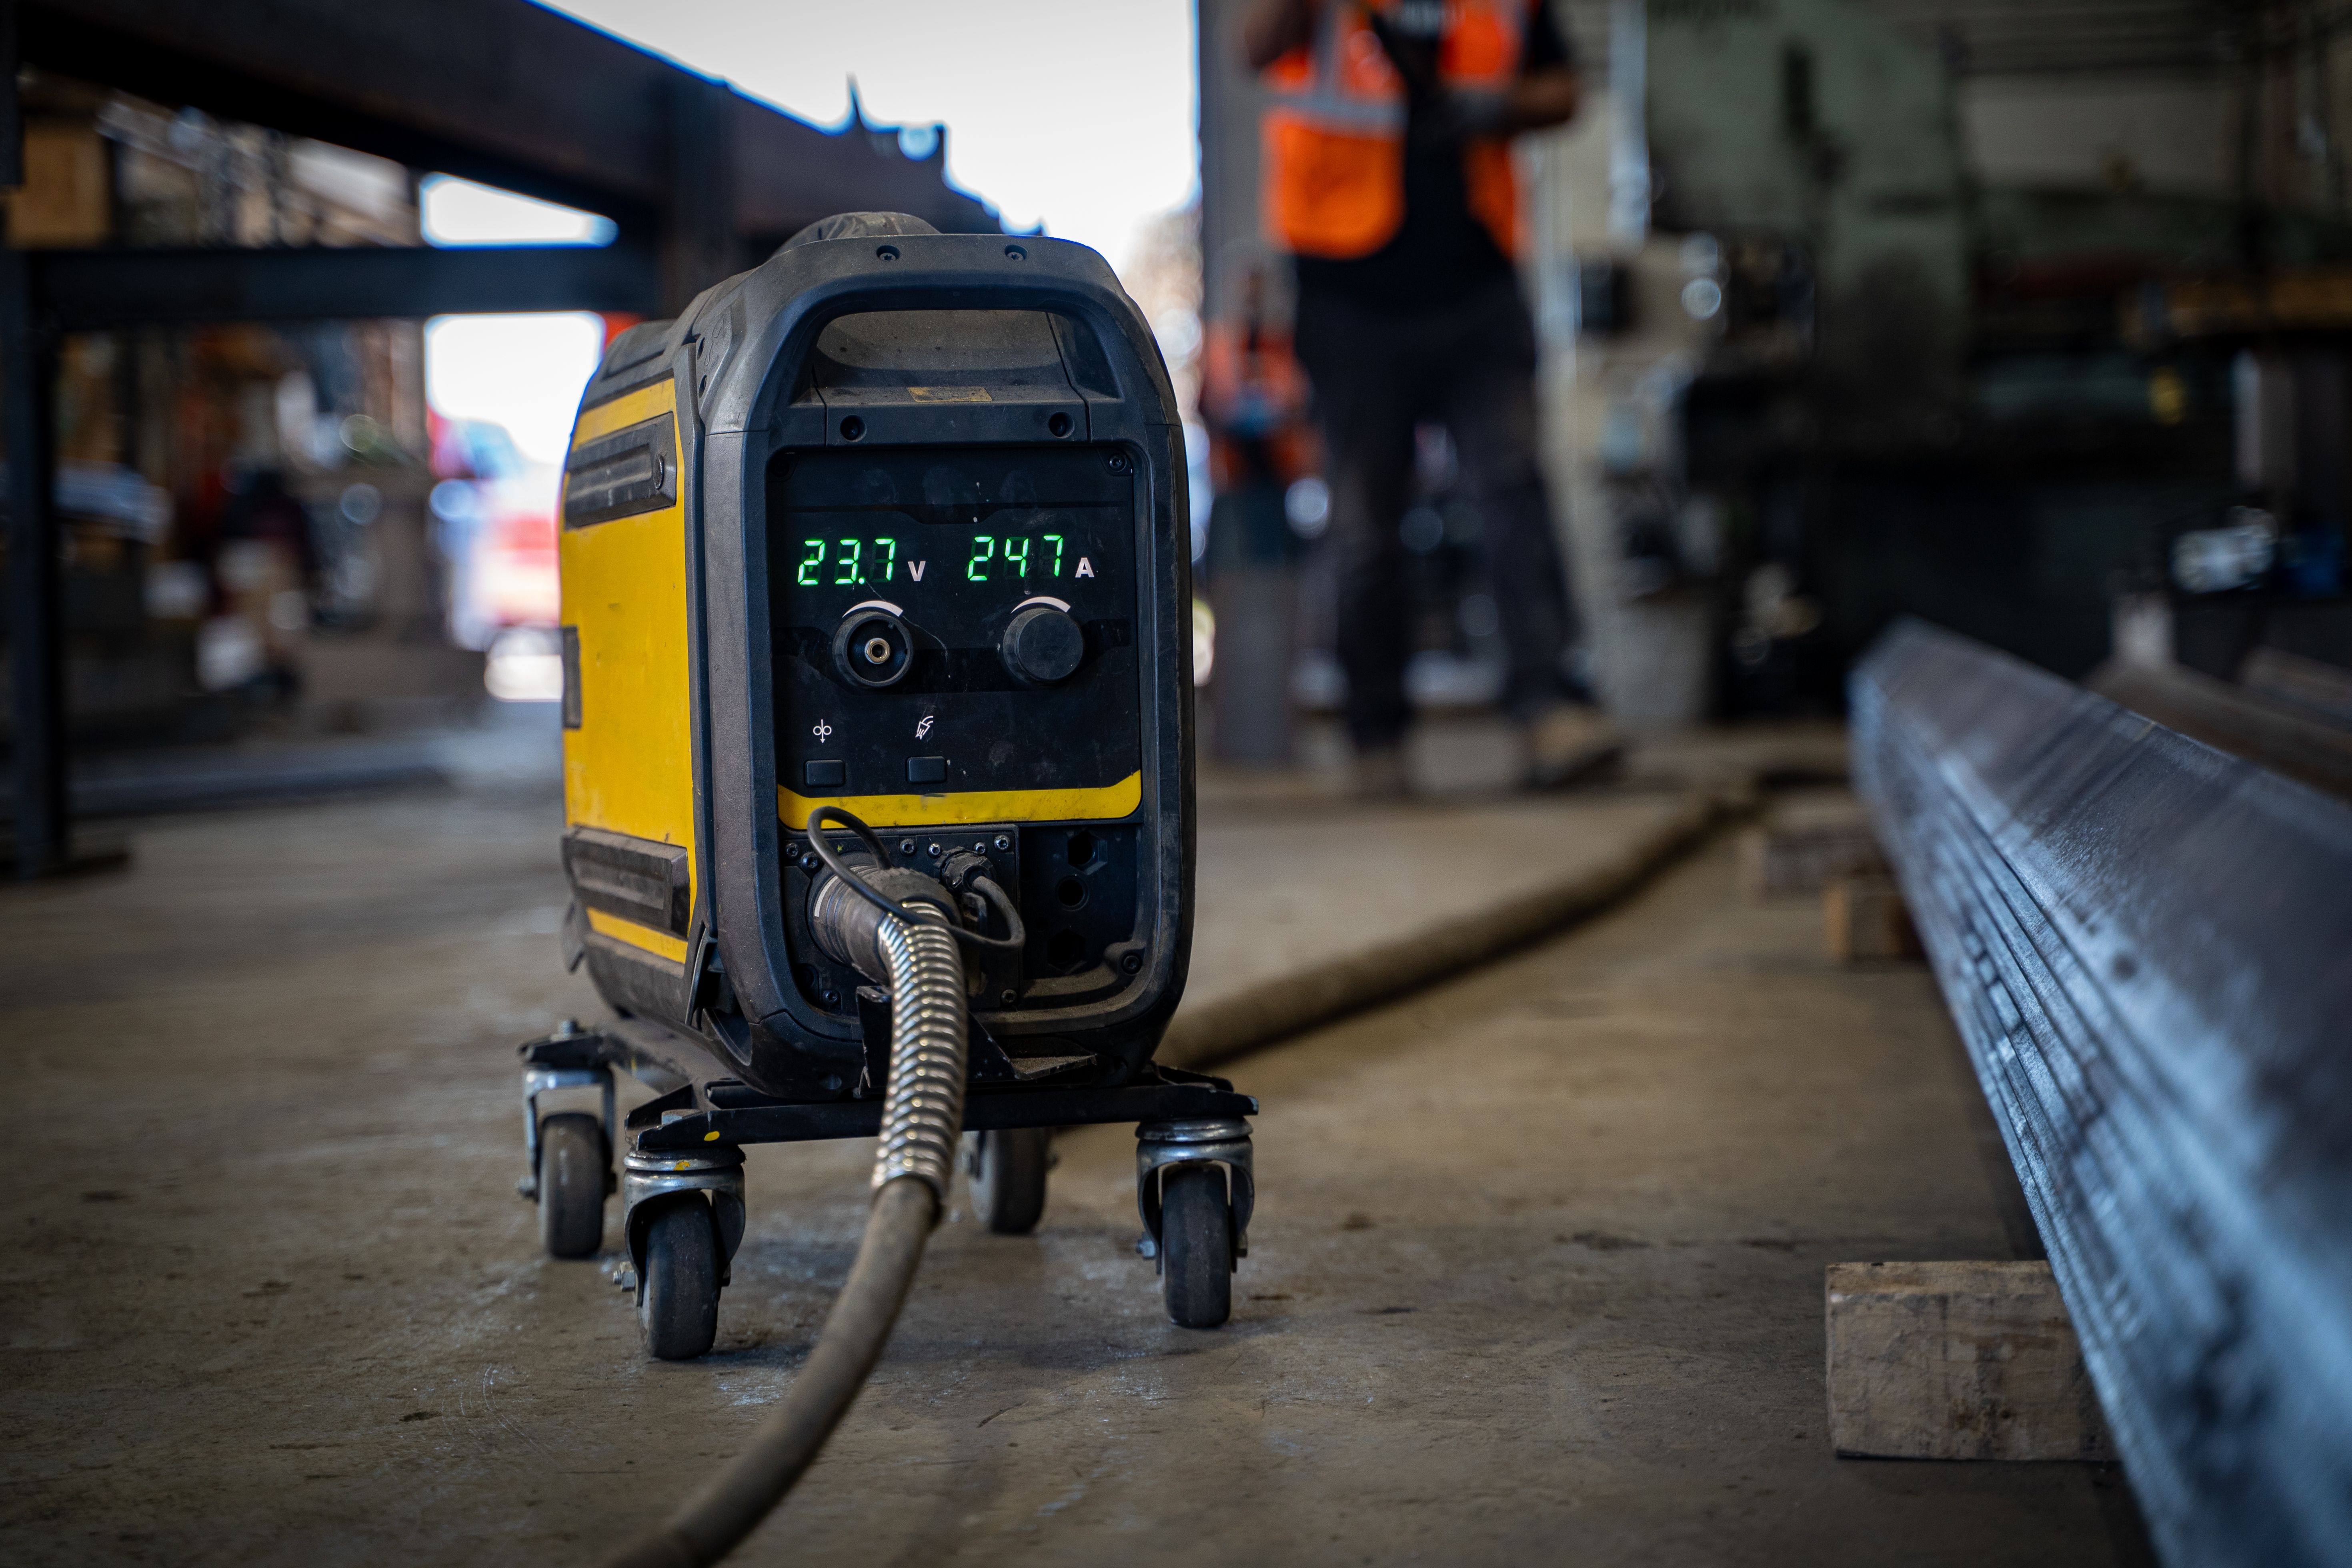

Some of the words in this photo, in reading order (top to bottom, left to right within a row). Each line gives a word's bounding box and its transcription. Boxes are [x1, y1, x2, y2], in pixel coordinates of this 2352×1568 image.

[797, 539, 896, 585] 23.7
[907, 561, 926, 582] V
[967, 535, 1063, 581] 247
[1075, 557, 1095, 578] A
